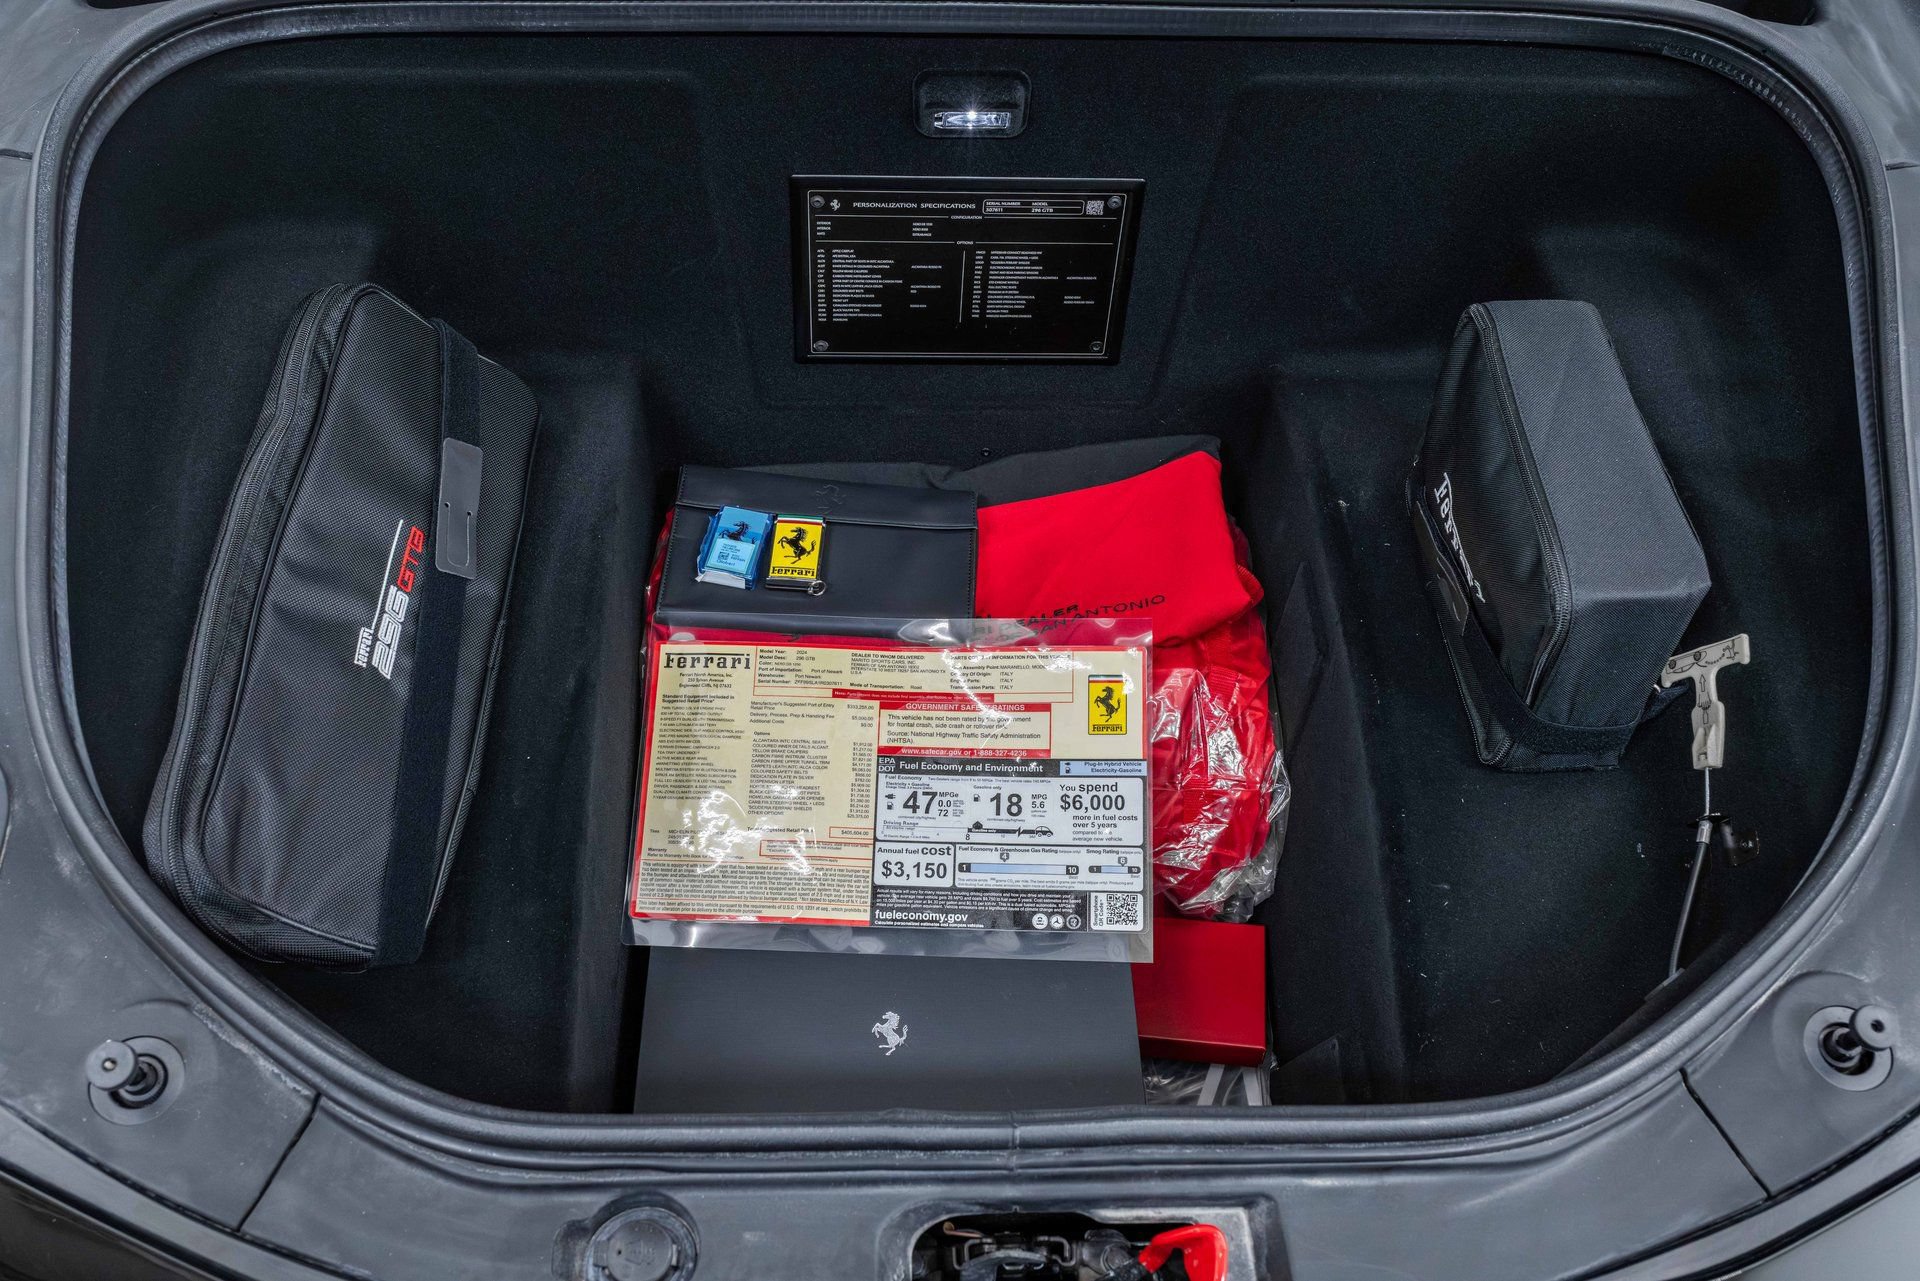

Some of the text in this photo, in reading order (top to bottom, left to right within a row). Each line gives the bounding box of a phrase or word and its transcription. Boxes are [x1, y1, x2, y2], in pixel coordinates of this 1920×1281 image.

[770, 566, 815, 577] Ferrari
[372, 526, 425, 679] 296 GTB
[1071, 594, 1166, 623] ANTONIO
[354, 626, 374, 668] Ferrari
[664, 652, 751, 669] Ferrari
[906, 703, 959, 711] GOVERNMENT
[977, 716, 985, 724] by
[1092, 724, 1122, 732] Ferrari
[980, 732, 998, 740] Safety
[901, 748, 962, 756] www.safecar.gov
[899, 761, 1043, 772] Fuel Economy and Environment
[1078, 782, 1118, 794] spend
[902, 790, 938, 814] 47
[938, 800, 952, 808] 0.0
[990, 793, 1022, 817] 18
[1031, 801, 1045, 809] 5.6
[1060, 793, 1125, 813] $6,000
[938, 809, 949, 817] 72
[921, 846, 952, 856] cost
[881, 860, 947, 880] $3,150
[1068, 866, 1076, 874] 10
[875, 910, 968, 923] fueleconomy.gov
